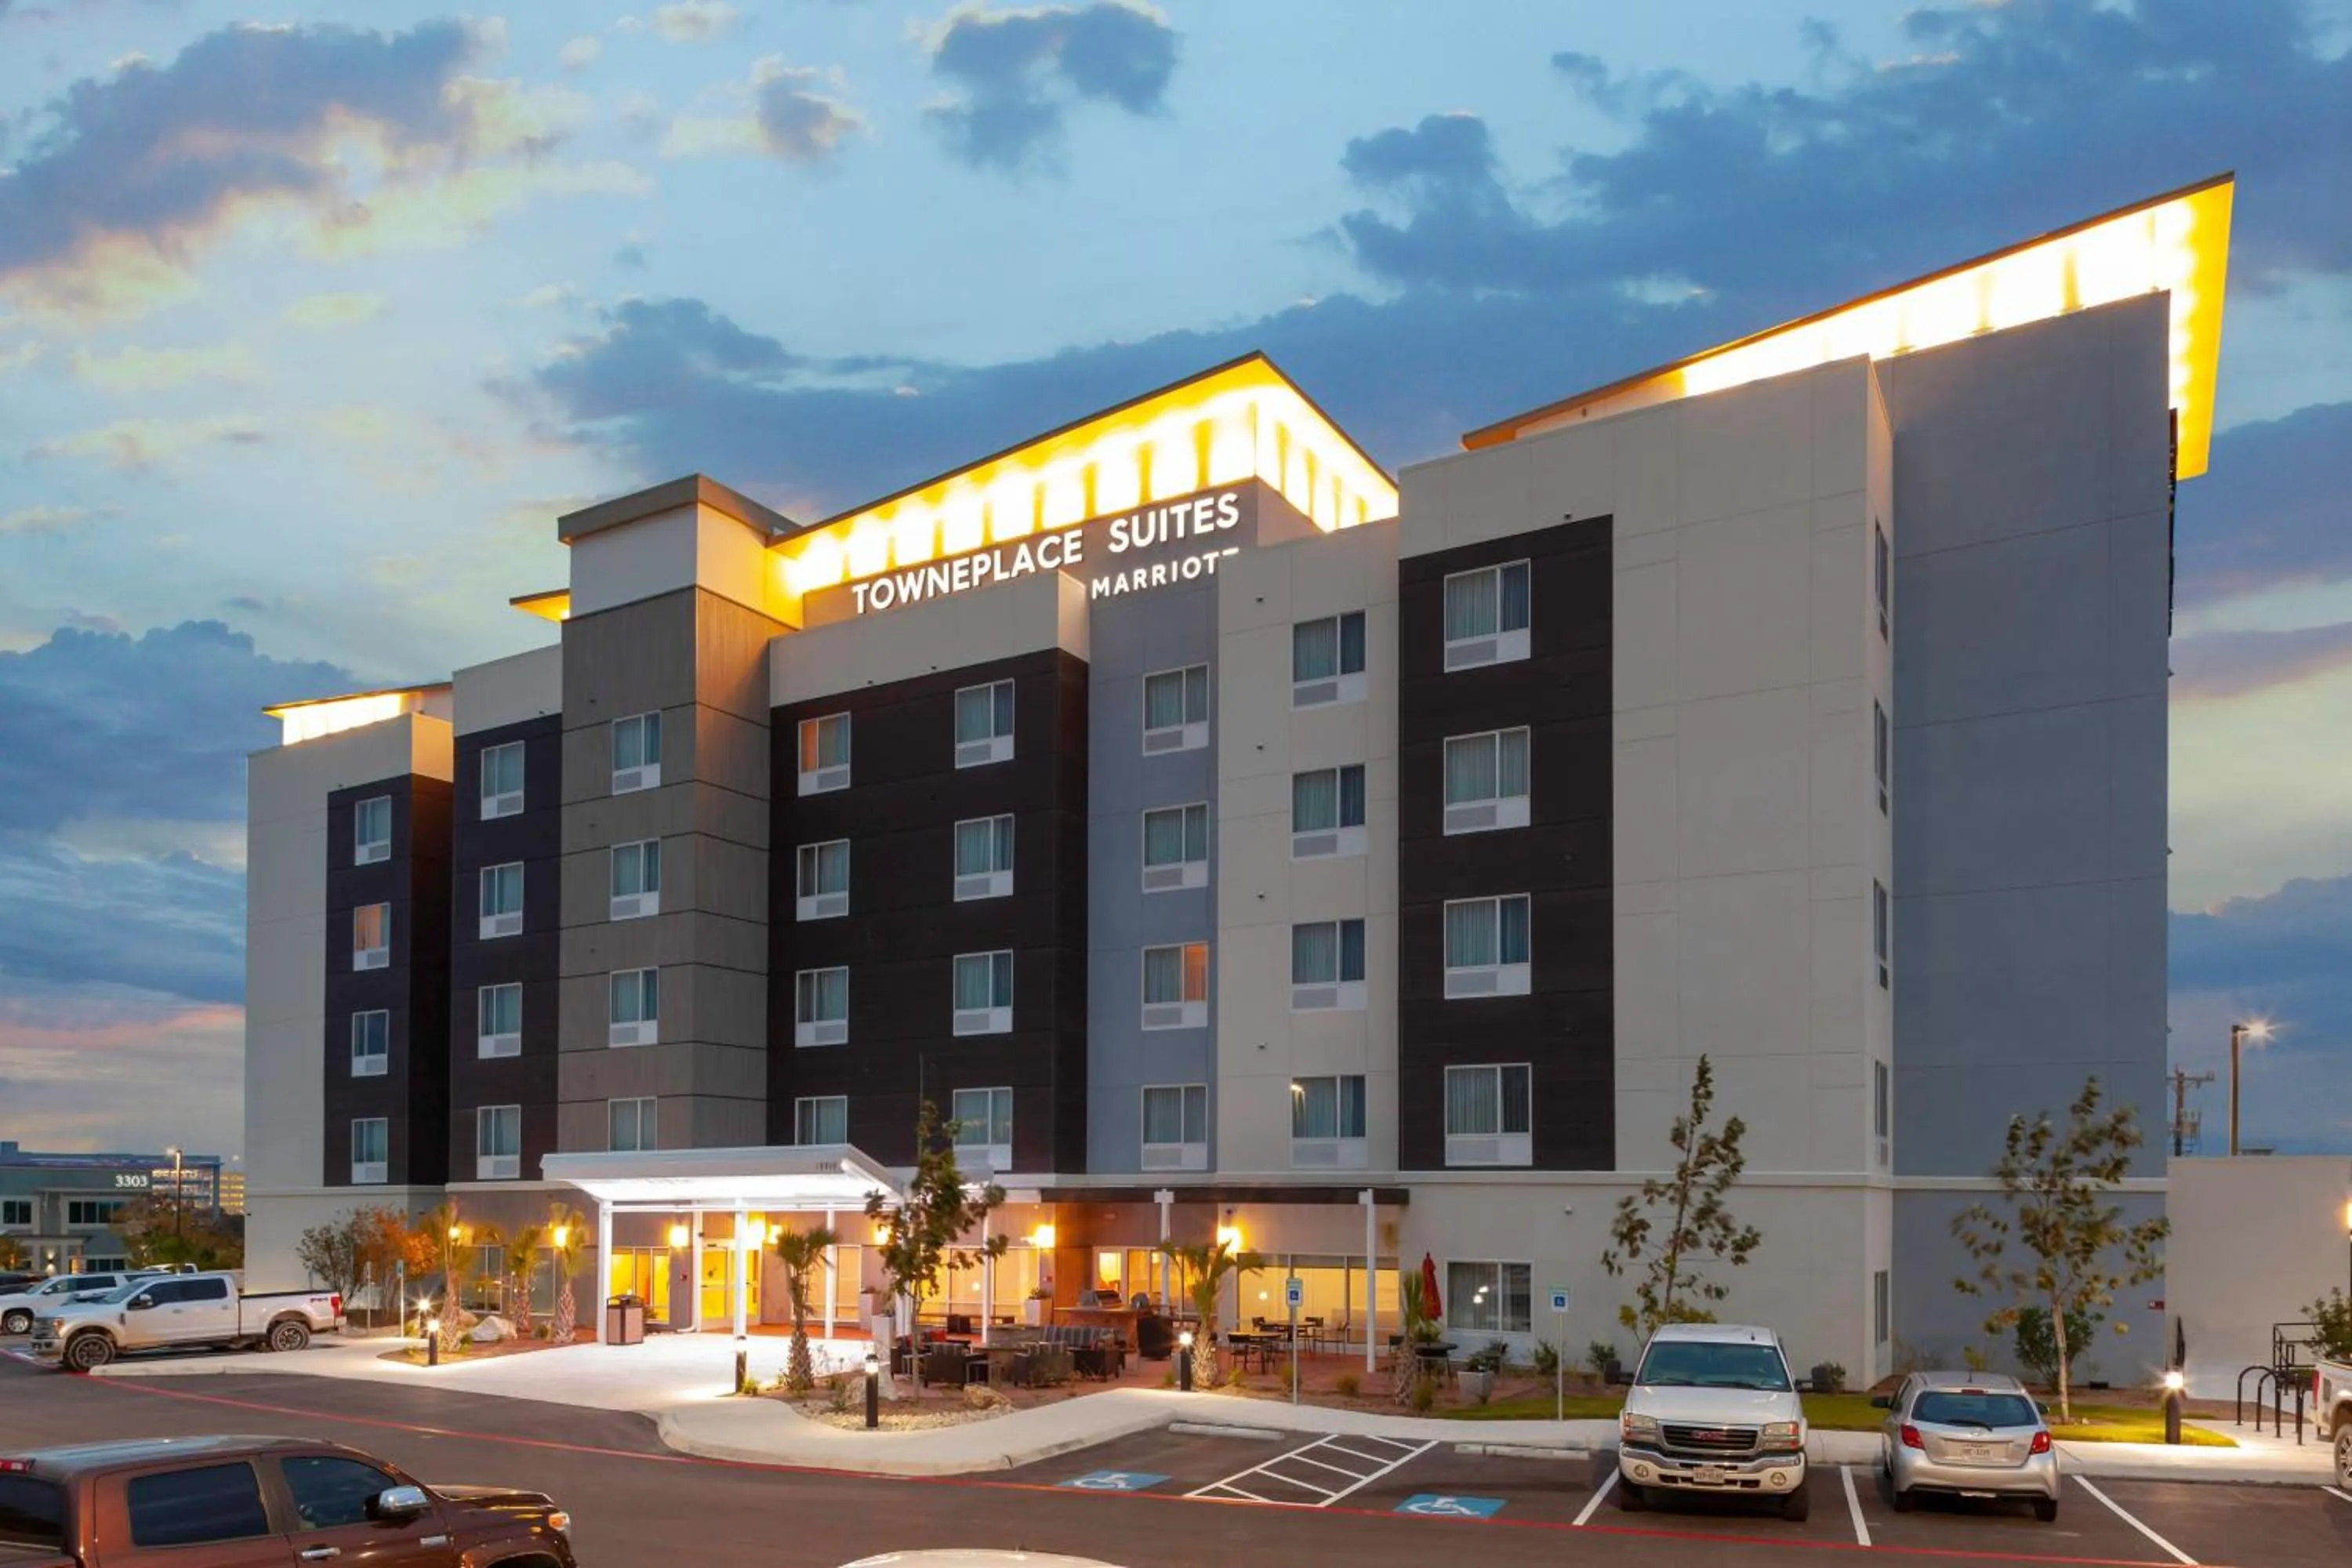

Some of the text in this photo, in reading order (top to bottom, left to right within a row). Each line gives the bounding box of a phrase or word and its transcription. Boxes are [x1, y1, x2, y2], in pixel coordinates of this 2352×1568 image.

[852, 492, 1240, 615] TOWNEPLACE SUITES
[1091, 546, 1240, 600] MARRIOT
[115, 1174, 147, 1188] 3303
